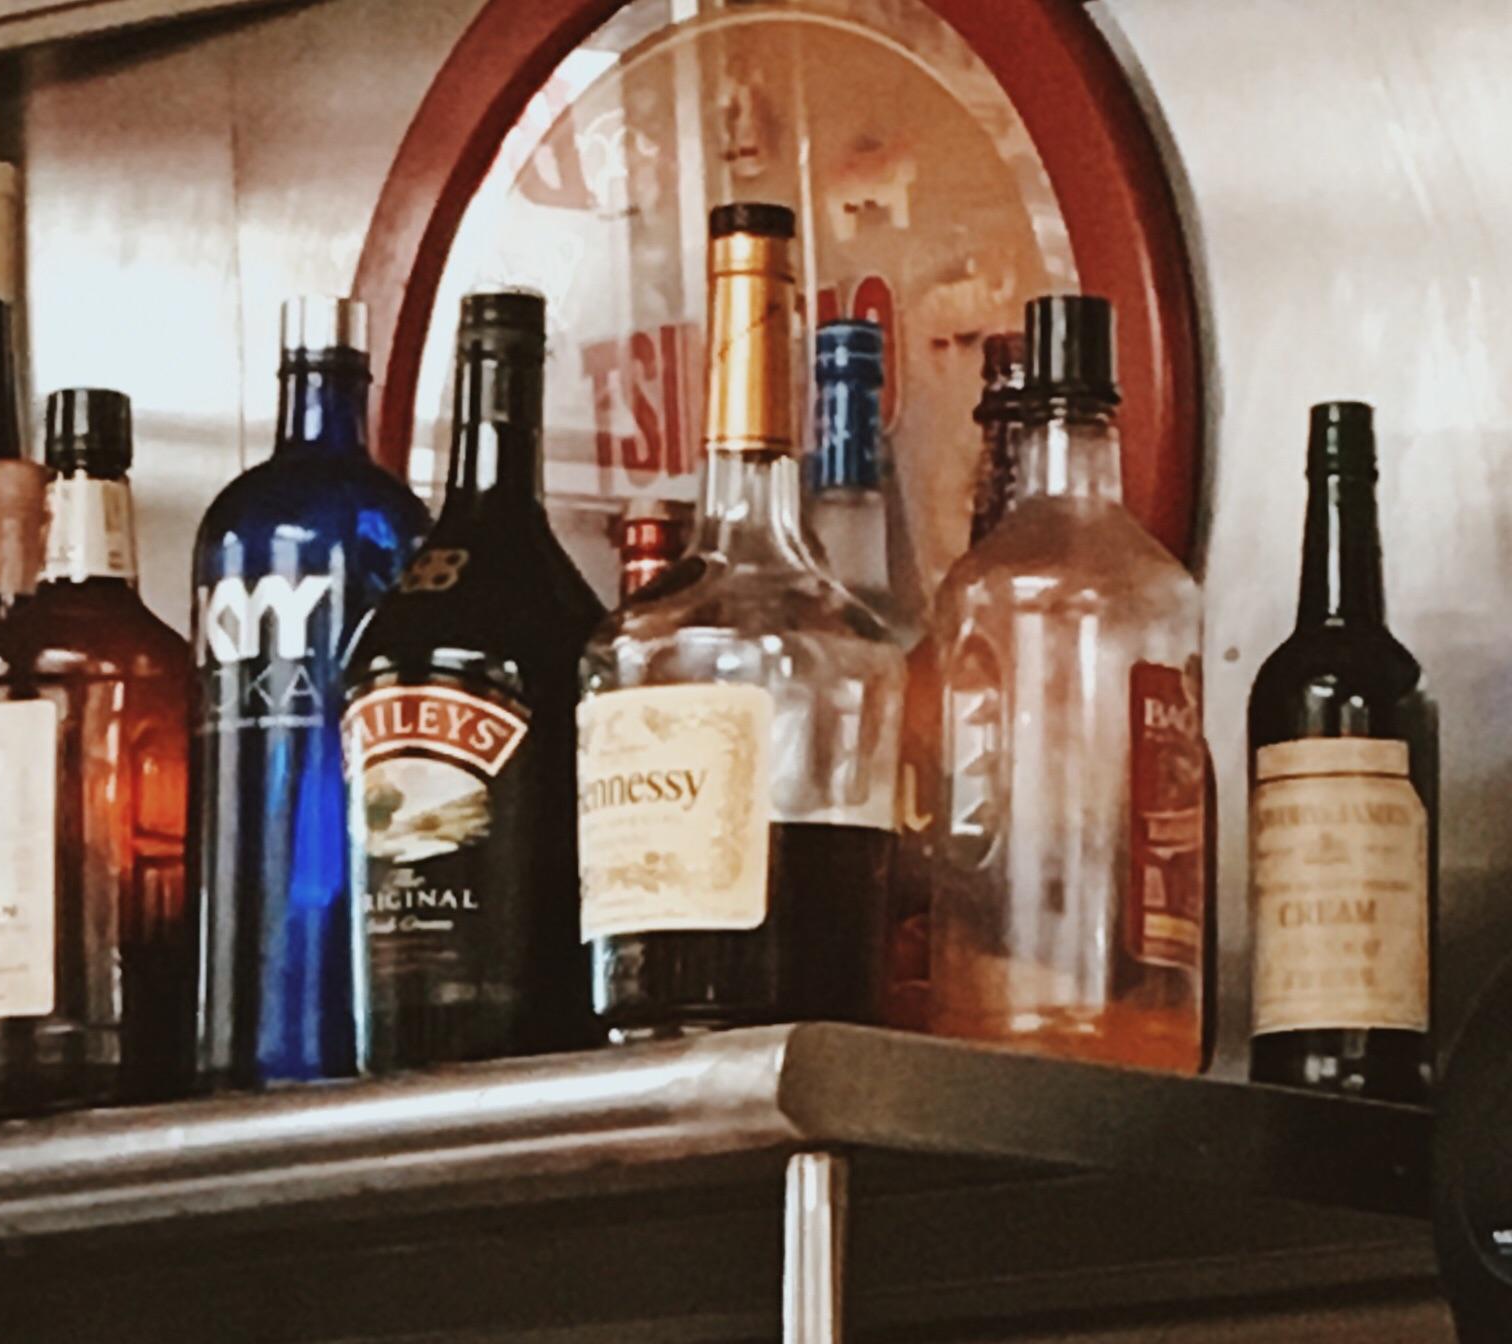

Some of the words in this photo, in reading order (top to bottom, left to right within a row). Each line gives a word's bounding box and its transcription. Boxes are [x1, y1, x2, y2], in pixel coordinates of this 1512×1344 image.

[197, 575, 335, 667] KYY
[356, 699, 508, 752] AILEYS
[362, 888, 479, 913] RIGINAL
